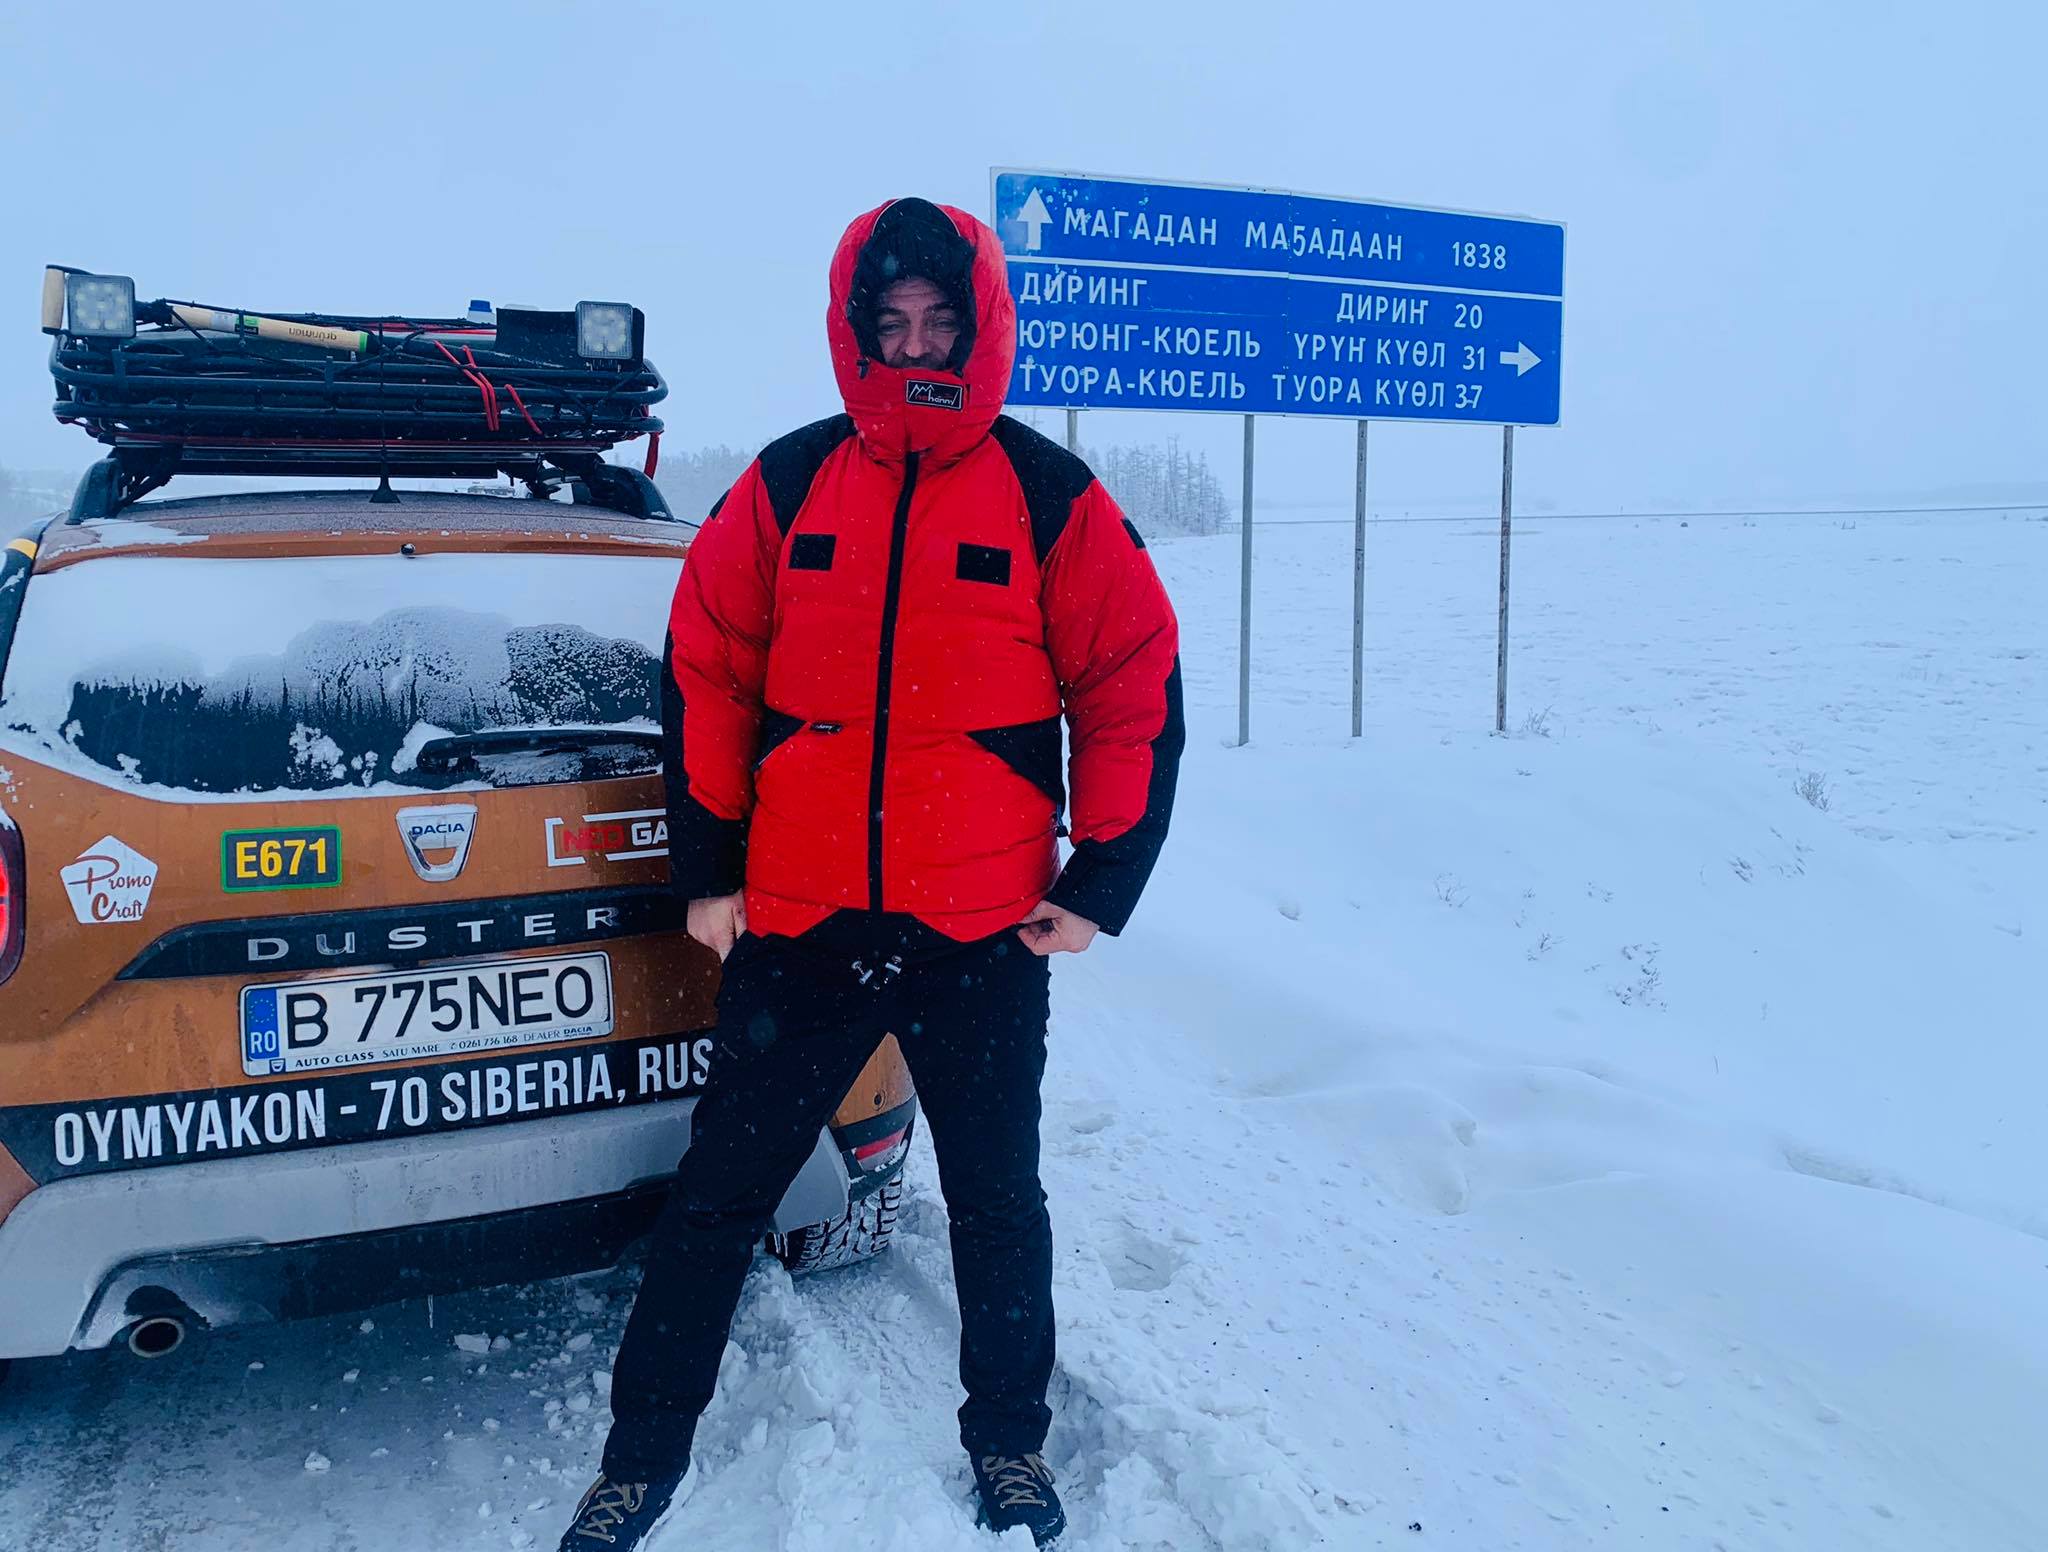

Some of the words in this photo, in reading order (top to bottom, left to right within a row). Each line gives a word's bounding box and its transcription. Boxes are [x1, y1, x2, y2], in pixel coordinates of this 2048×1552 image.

[1063, 206, 1217, 247] МАГАДАН
[1452, 241, 1507, 270] 1838
[1019, 272, 1147, 306] ДИРИНГ
[1454, 303, 1483, 330] 20
[1019, 319, 1261, 359] ЮРЮНГ-КЮЕЛЬ
[1462, 345, 1486, 371] 31
[1018, 361, 1247, 400] ТУОРА-КЮЕЛЬ
[1272, 374, 1362, 404] ТУОРА
[1455, 383, 1483, 409] 37
[411, 822, 465, 836] DACIA
[68, 855, 152, 895] Promo
[235, 838, 327, 879] E671
[91, 892, 143, 921] Craft
[247, 906, 621, 961] DUSTER
[286, 992, 329, 1050] B
[250, 1030, 277, 1053] RO
[295, 1056, 332, 1068] AUTO
[335, 1052, 375, 1064] CLASS
[382, 1047, 409, 1058] SATU
[412, 1043, 439, 1055] MARE
[458, 1038, 482, 1050] 0261
[503, 1034, 518, 1045] 168
[524, 1030, 560, 1043] DEALER
[563, 1026, 593, 1035] DACIA
[54, 1087, 326, 1166] OYMYAKON
[370, 1076, 429, 1131] 70
[441, 1053, 626, 1123] SIBERIA,
[638, 1038, 713, 1096] RUS
